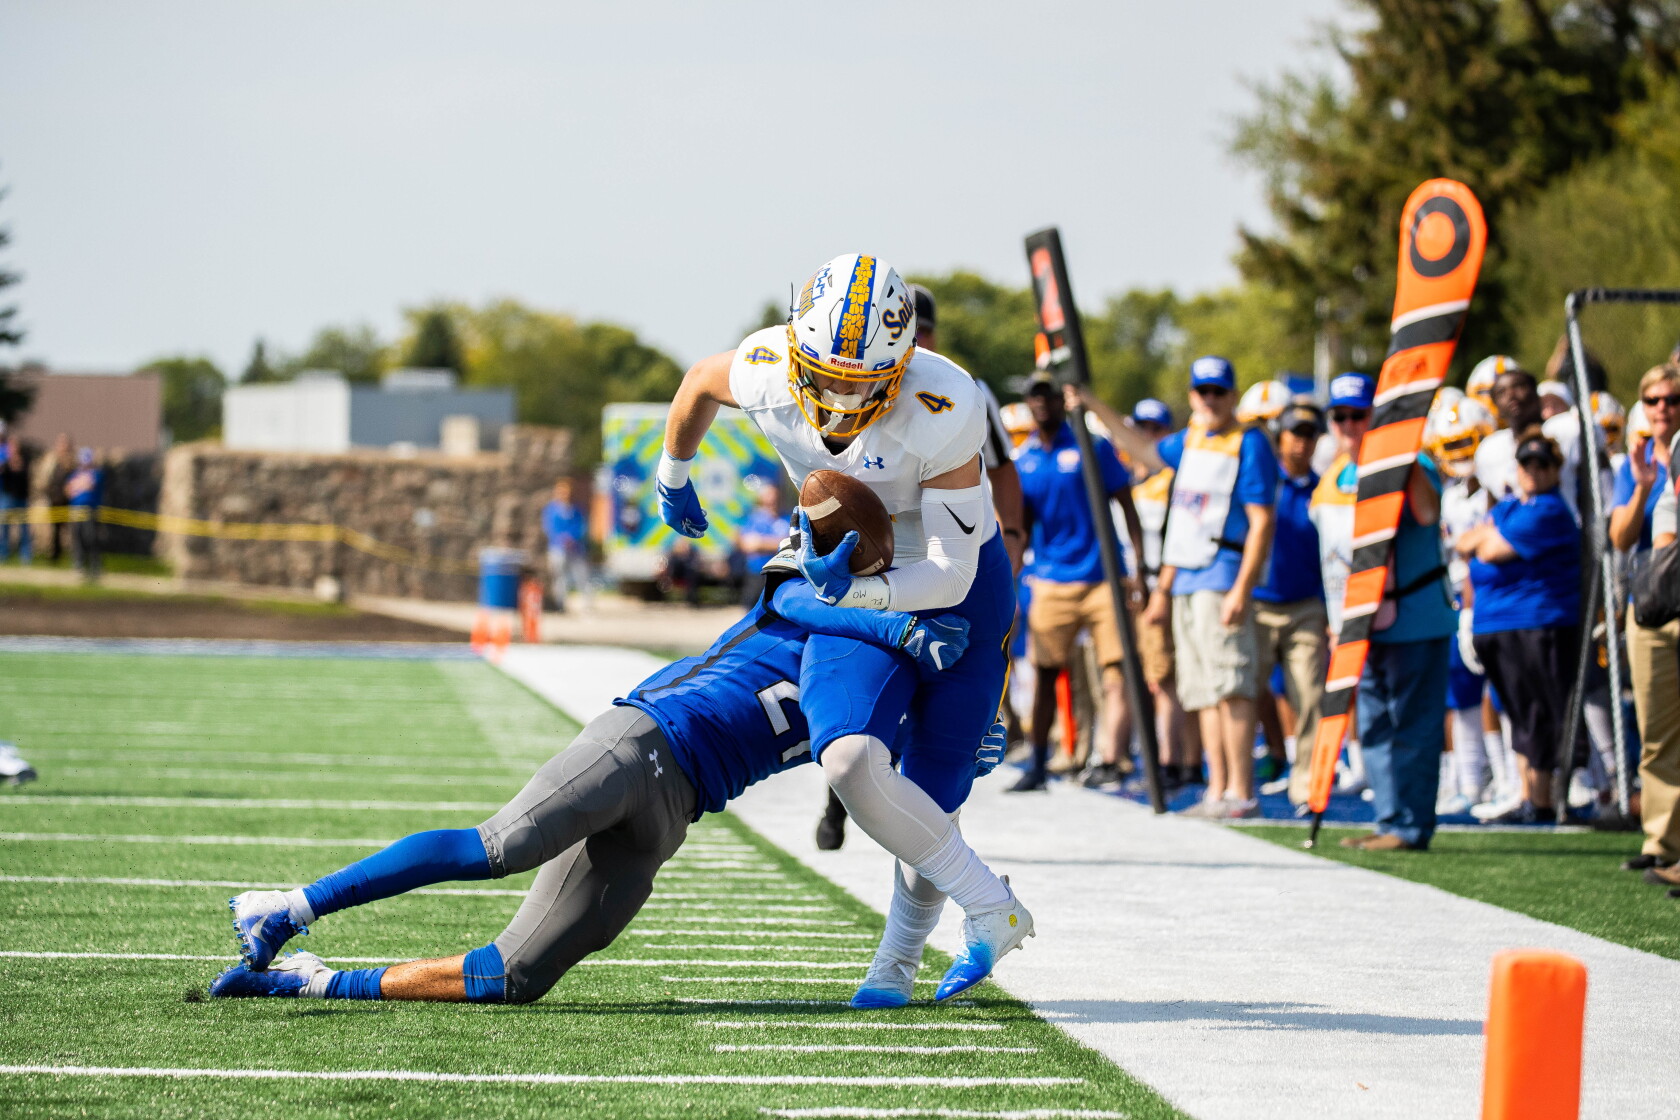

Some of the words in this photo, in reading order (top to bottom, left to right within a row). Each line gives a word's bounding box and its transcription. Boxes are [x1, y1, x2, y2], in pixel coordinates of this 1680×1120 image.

[744, 345, 783, 365] 4
[830, 357, 864, 370] Riddell
[915, 390, 956, 415] 4
